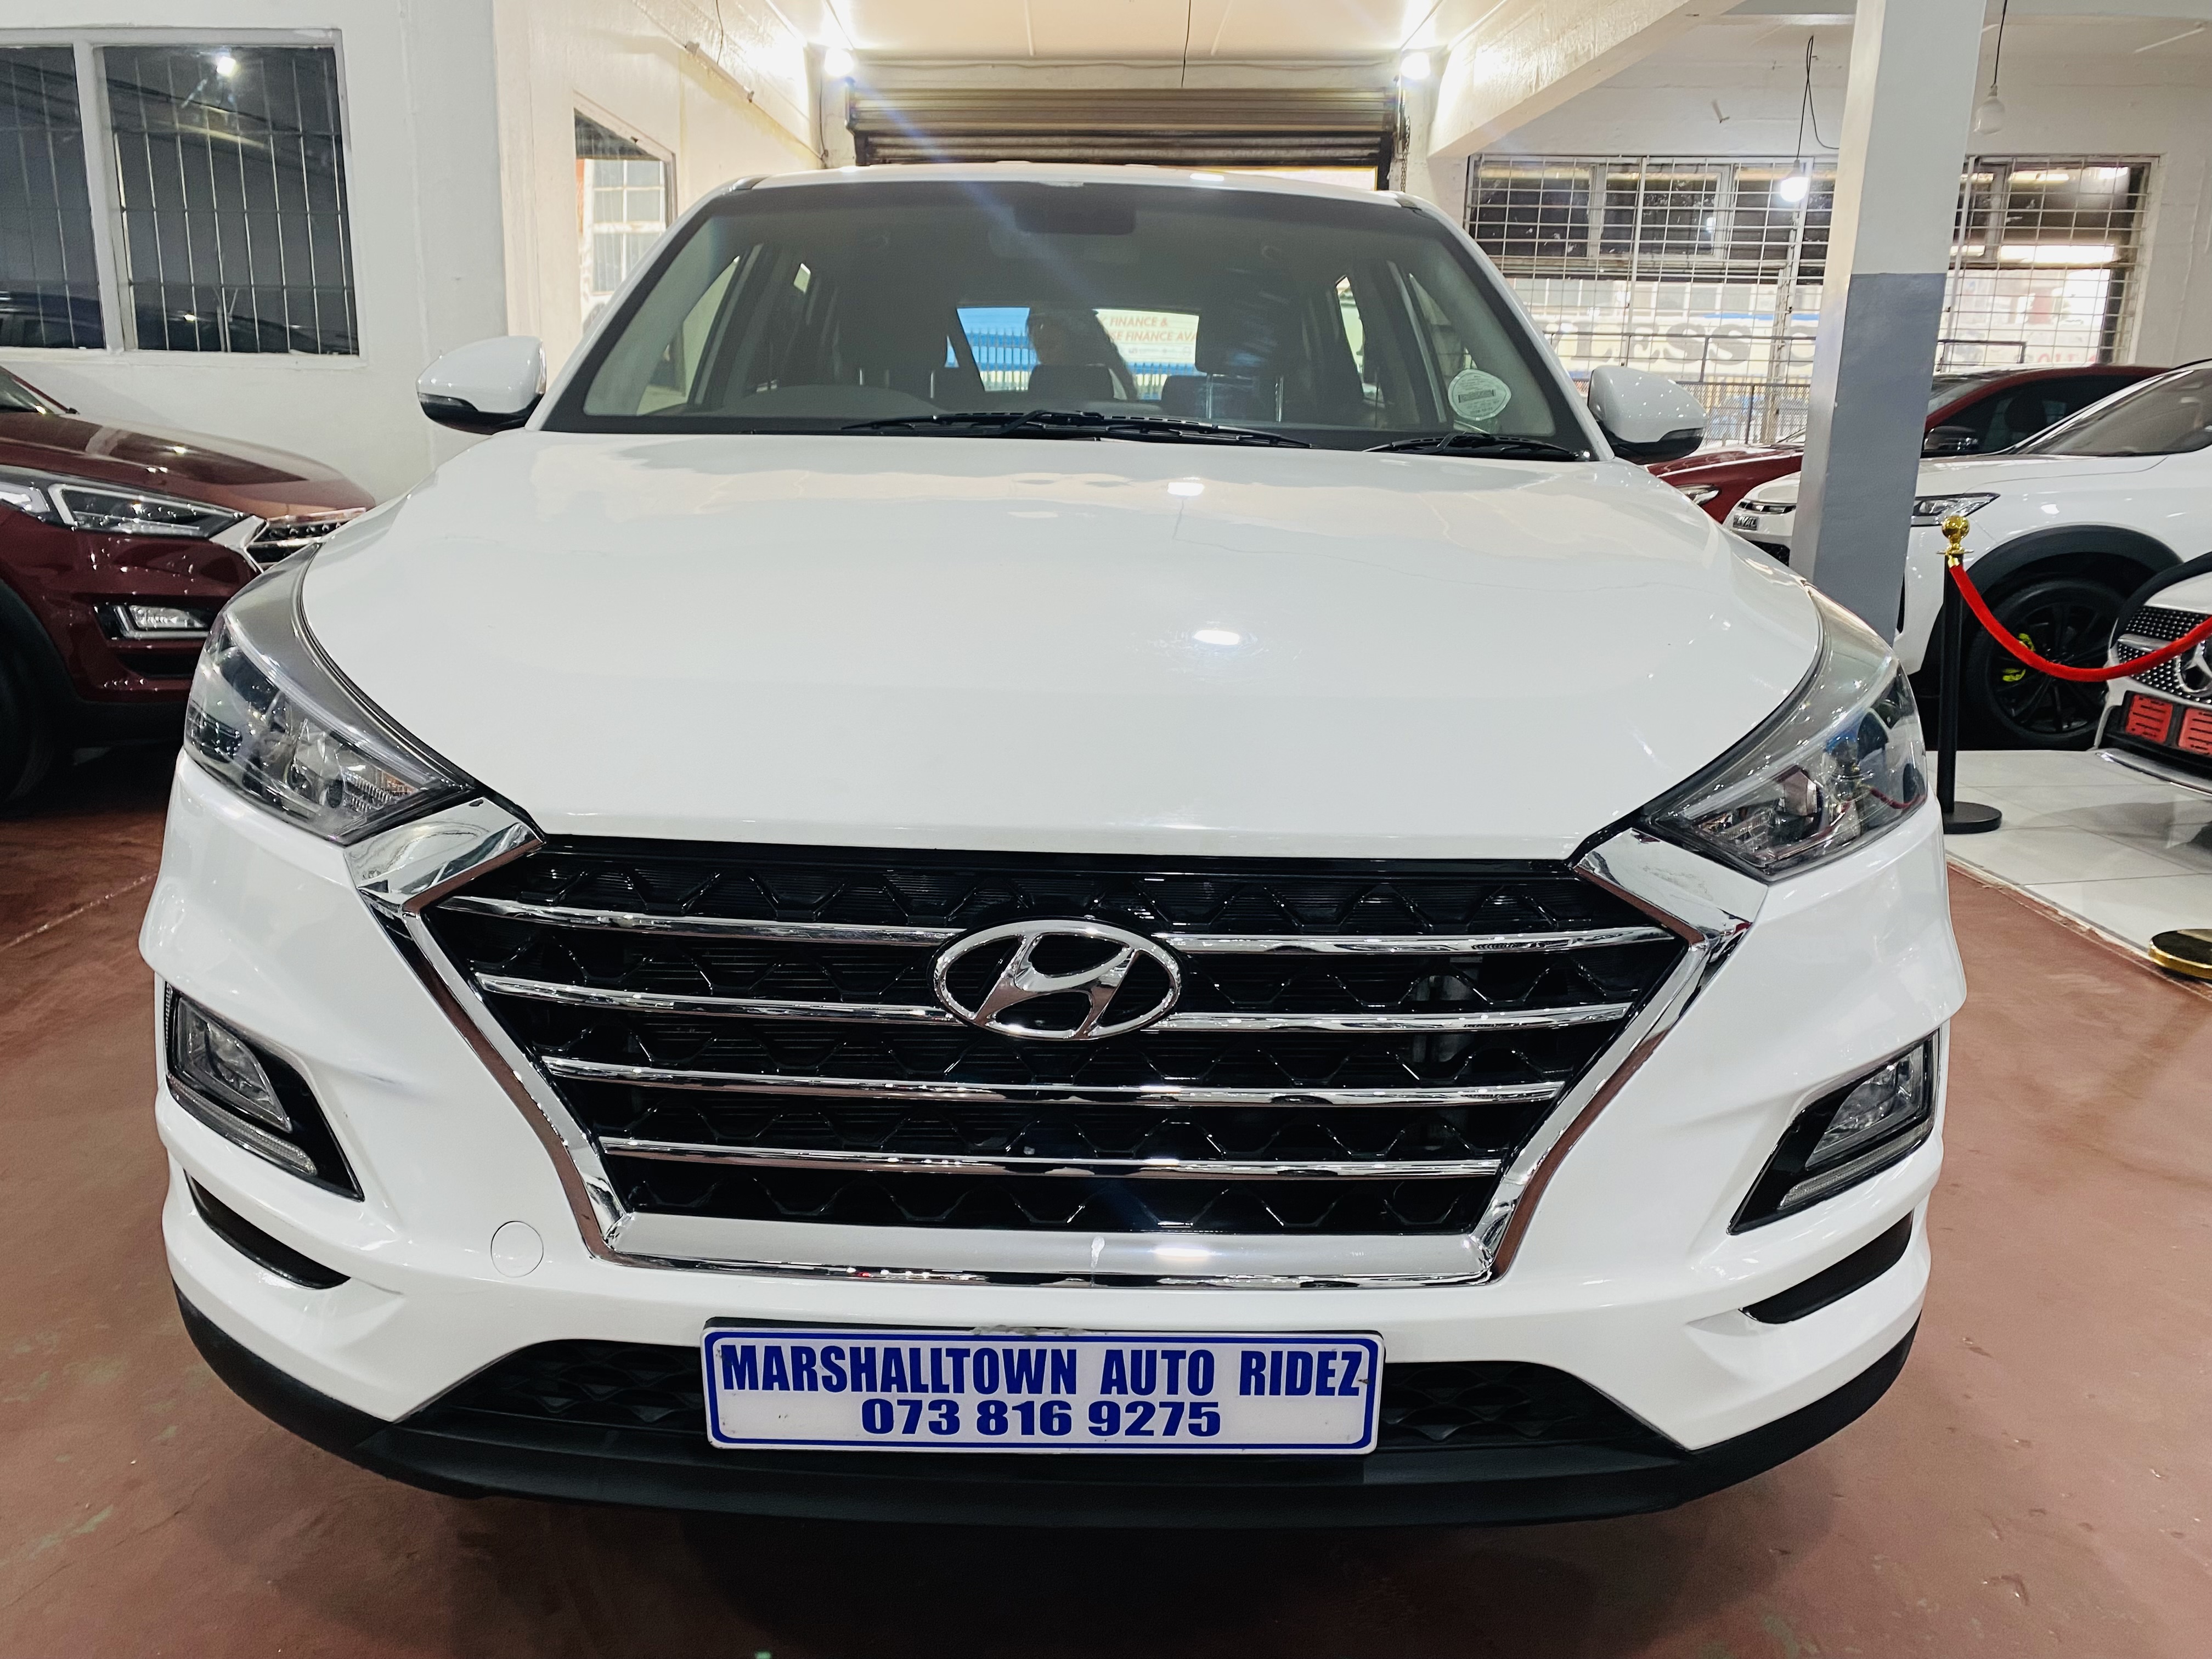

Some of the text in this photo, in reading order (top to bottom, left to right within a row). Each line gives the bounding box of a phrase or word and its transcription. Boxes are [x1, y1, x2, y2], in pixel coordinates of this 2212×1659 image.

[1109, 317, 1156, 327] FINANCE
[1160, 317, 1168, 327] &
[1125, 331, 1172, 341] FINANCE
[720, 1344, 1363, 1397] MARSHALLTOWN AUTO RIDEZ
[861, 1398, 1221, 1437] 073 816 9275
